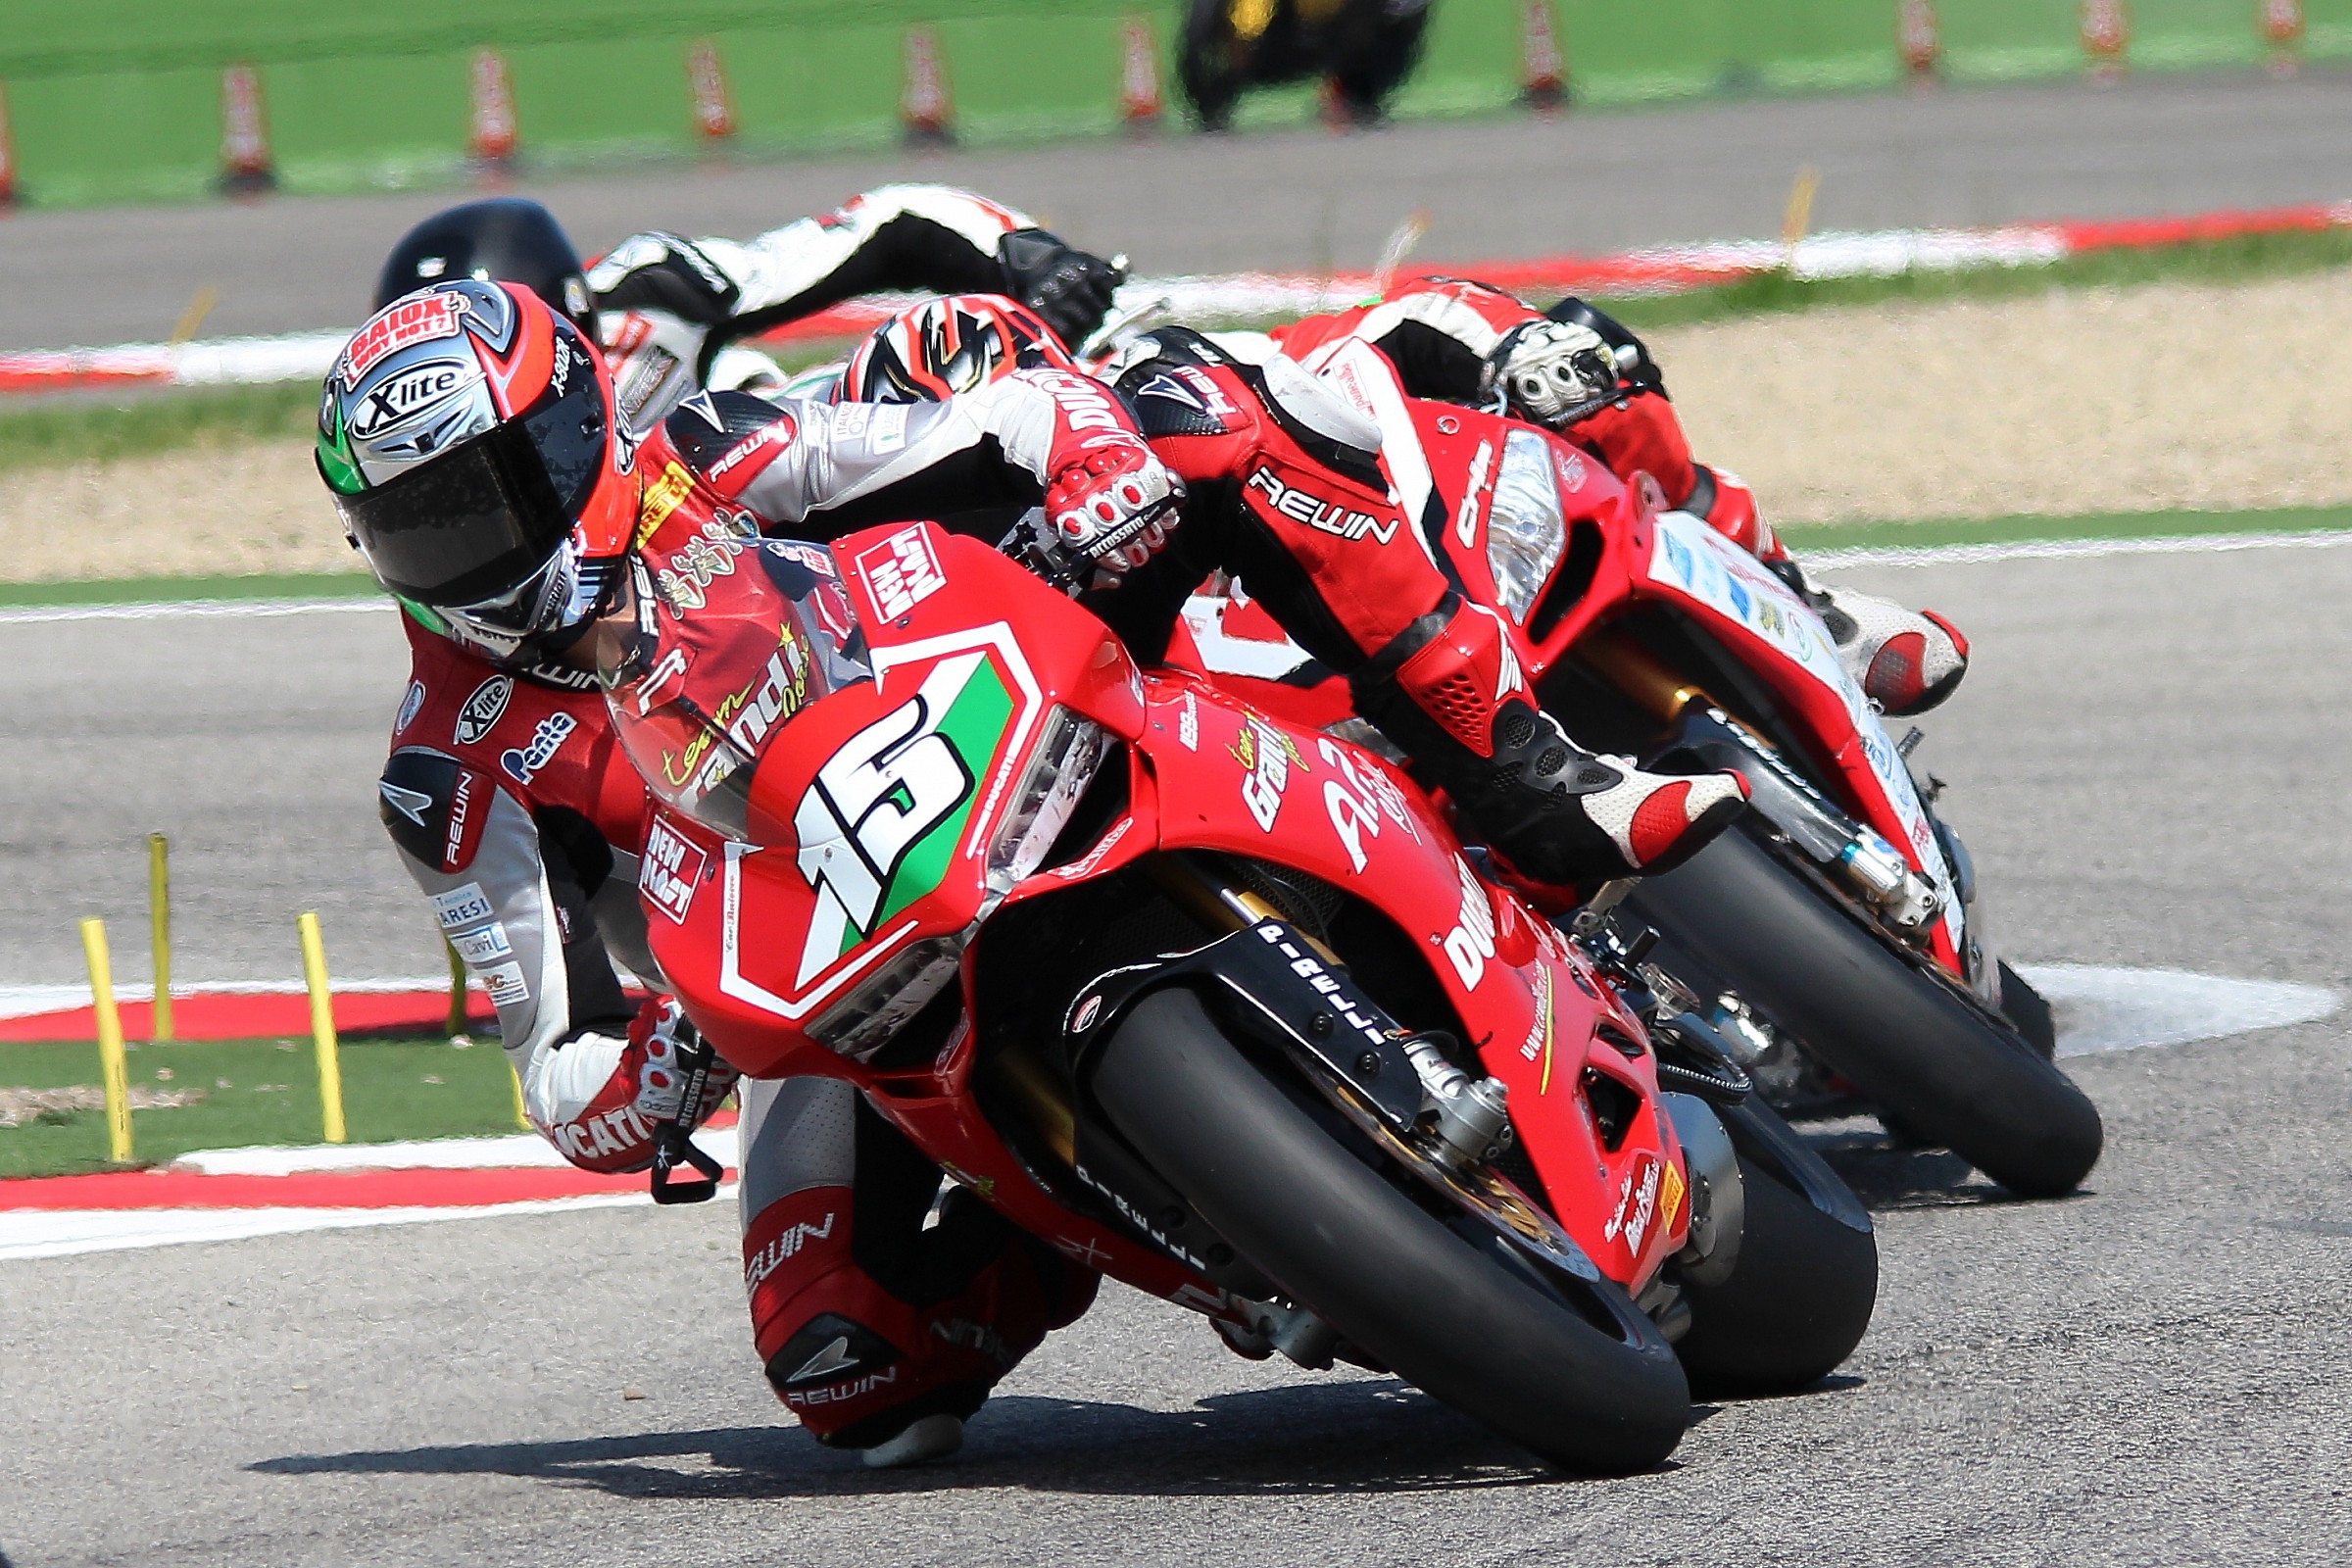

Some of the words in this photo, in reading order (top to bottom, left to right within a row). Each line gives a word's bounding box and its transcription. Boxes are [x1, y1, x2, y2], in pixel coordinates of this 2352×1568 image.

[350, 296, 448, 358] BAIOX
[354, 335, 391, 369] WHY
[396, 320, 430, 343] NOT
[365, 370, 459, 435] X-lite
[709, 420, 790, 482] REWIN
[1248, 466, 1399, 544] REWIN
[461, 684, 506, 737] X-lite
[662, 678, 756, 786] team
[984, 755, 1015, 812] DUCATI
[447, 771, 473, 865] REWIN
[793, 694, 975, 940] 15
[647, 823, 686, 874] NEW
[1256, 923, 1387, 1046] PIRELLI
[552, 1106, 652, 1159] UCATI
[1075, 1164, 1206, 1271] PIRELLI
[787, 1365, 897, 1406] REWIN
